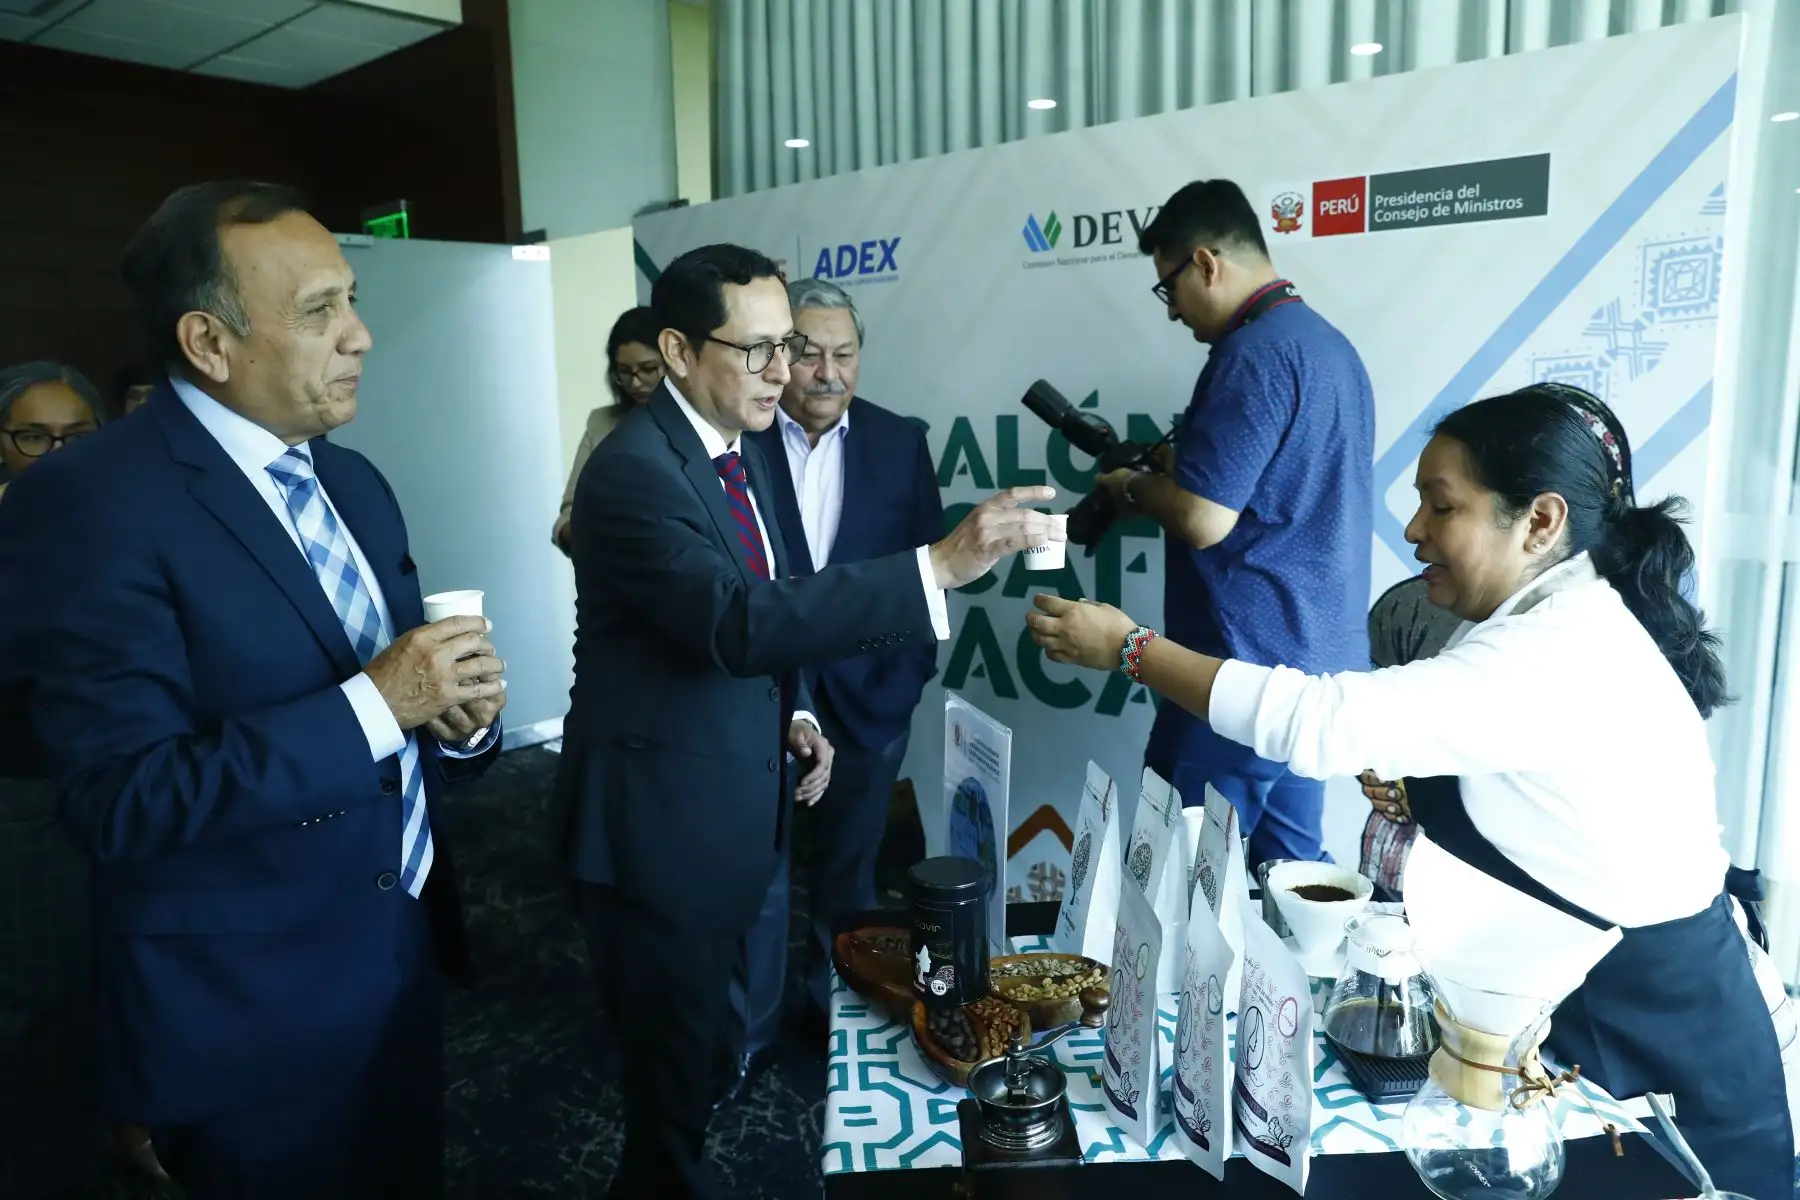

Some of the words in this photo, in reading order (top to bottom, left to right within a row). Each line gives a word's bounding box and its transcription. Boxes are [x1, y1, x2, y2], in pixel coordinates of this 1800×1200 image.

[1319, 194, 1360, 216] PERÚ
[1375, 189, 1454, 207] Presidencia
[1456, 183, 1480, 200] del
[1374, 206, 1430, 223] Consejo
[1431, 203, 1451, 217] de
[1453, 197, 1524, 215] Ministros
[1072, 205, 1164, 249] DEV
[813, 237, 902, 280] ADEX
